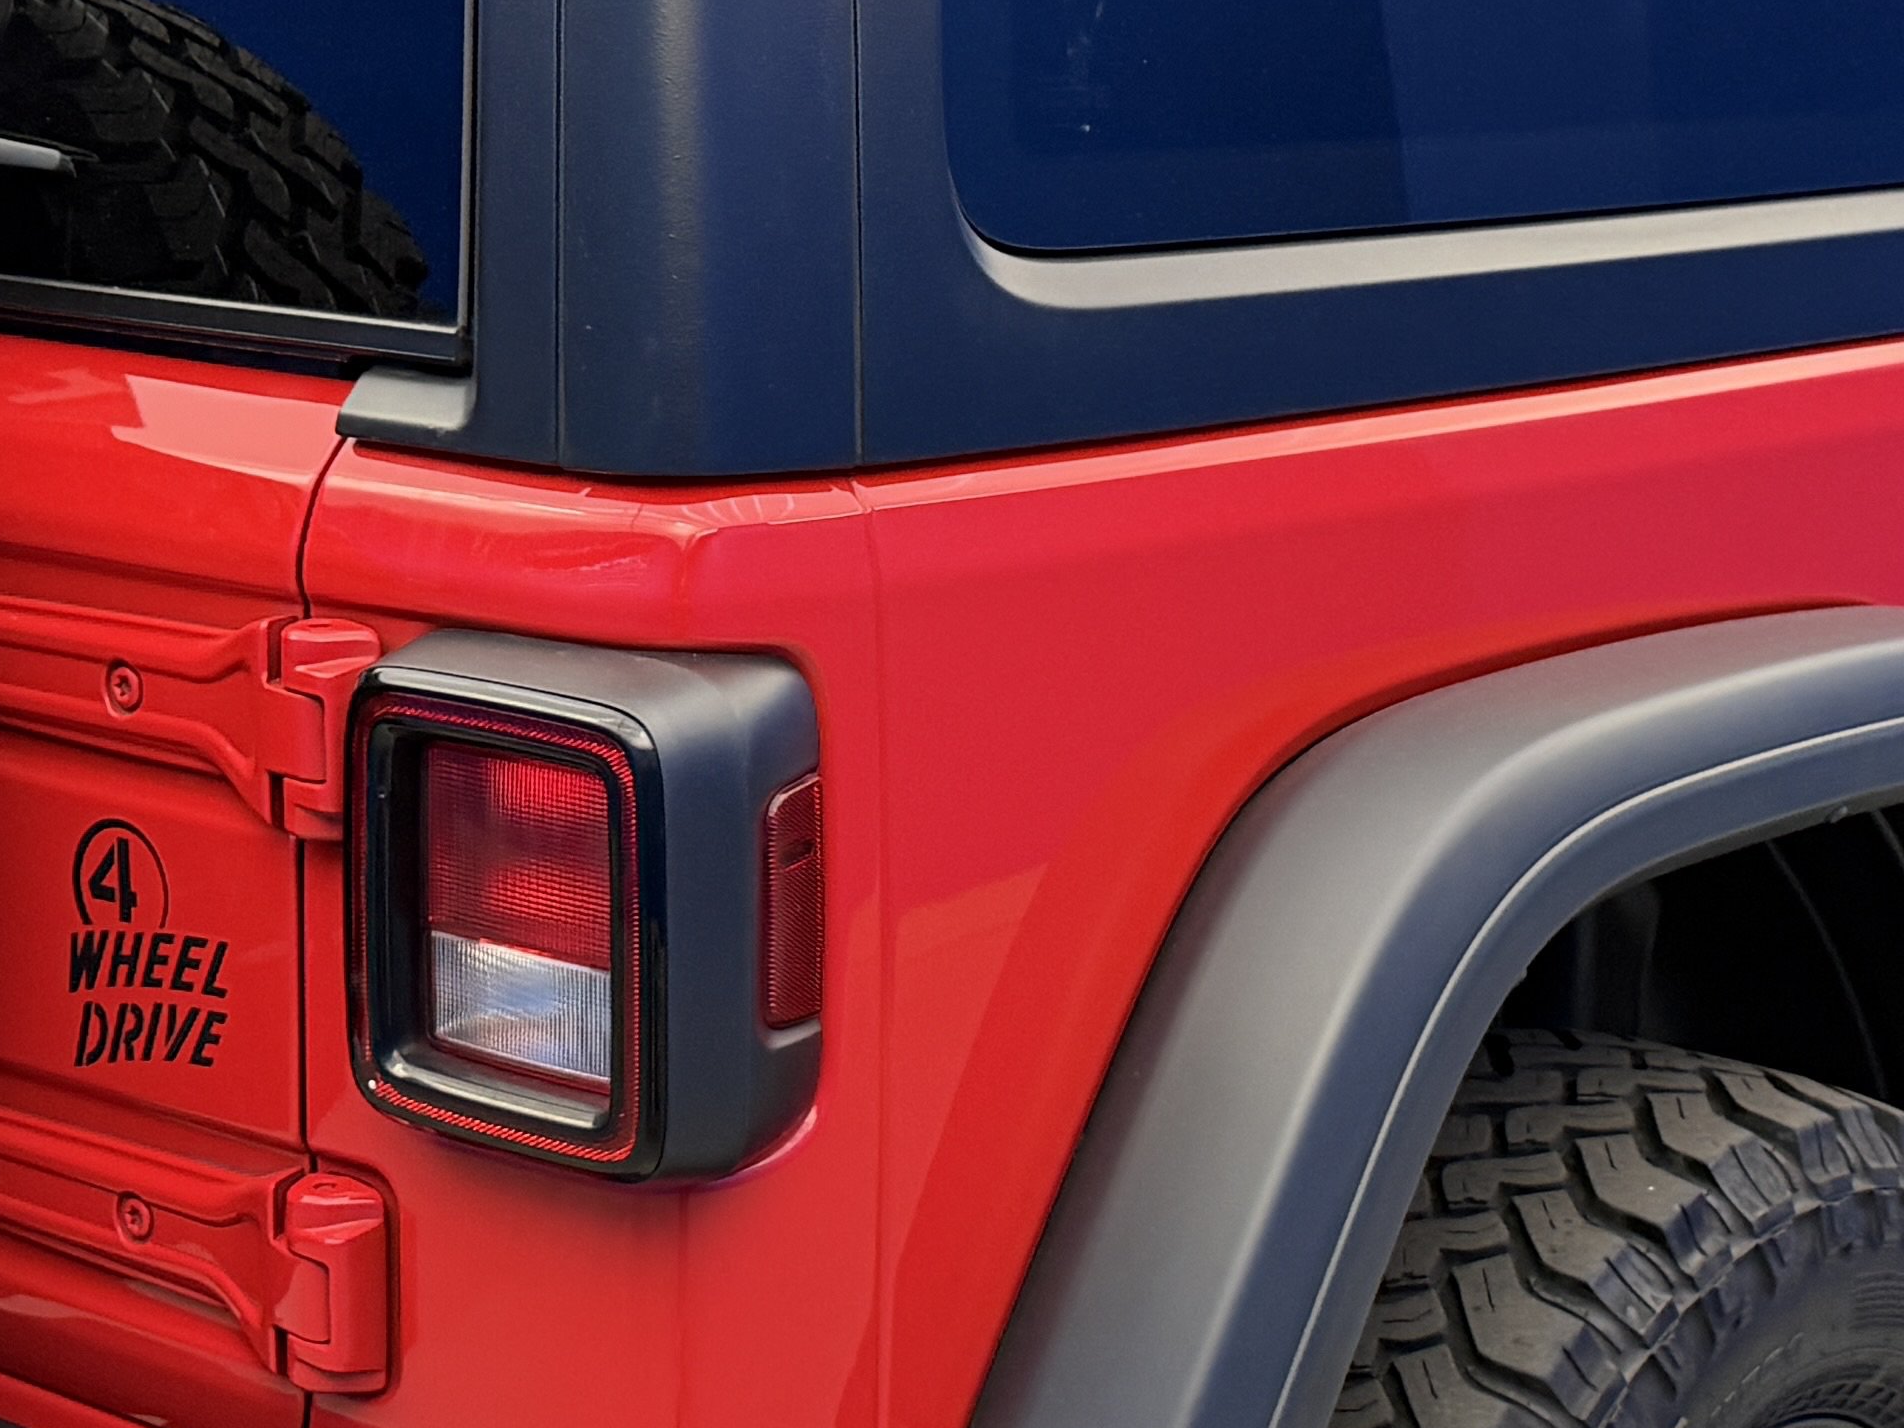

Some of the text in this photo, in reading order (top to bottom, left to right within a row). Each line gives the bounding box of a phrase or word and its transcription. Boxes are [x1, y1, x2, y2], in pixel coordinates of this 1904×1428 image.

[88, 837, 138, 923] 4
[68, 929, 228, 999] WHEEL
[74, 1001, 228, 1068] DRIVE
